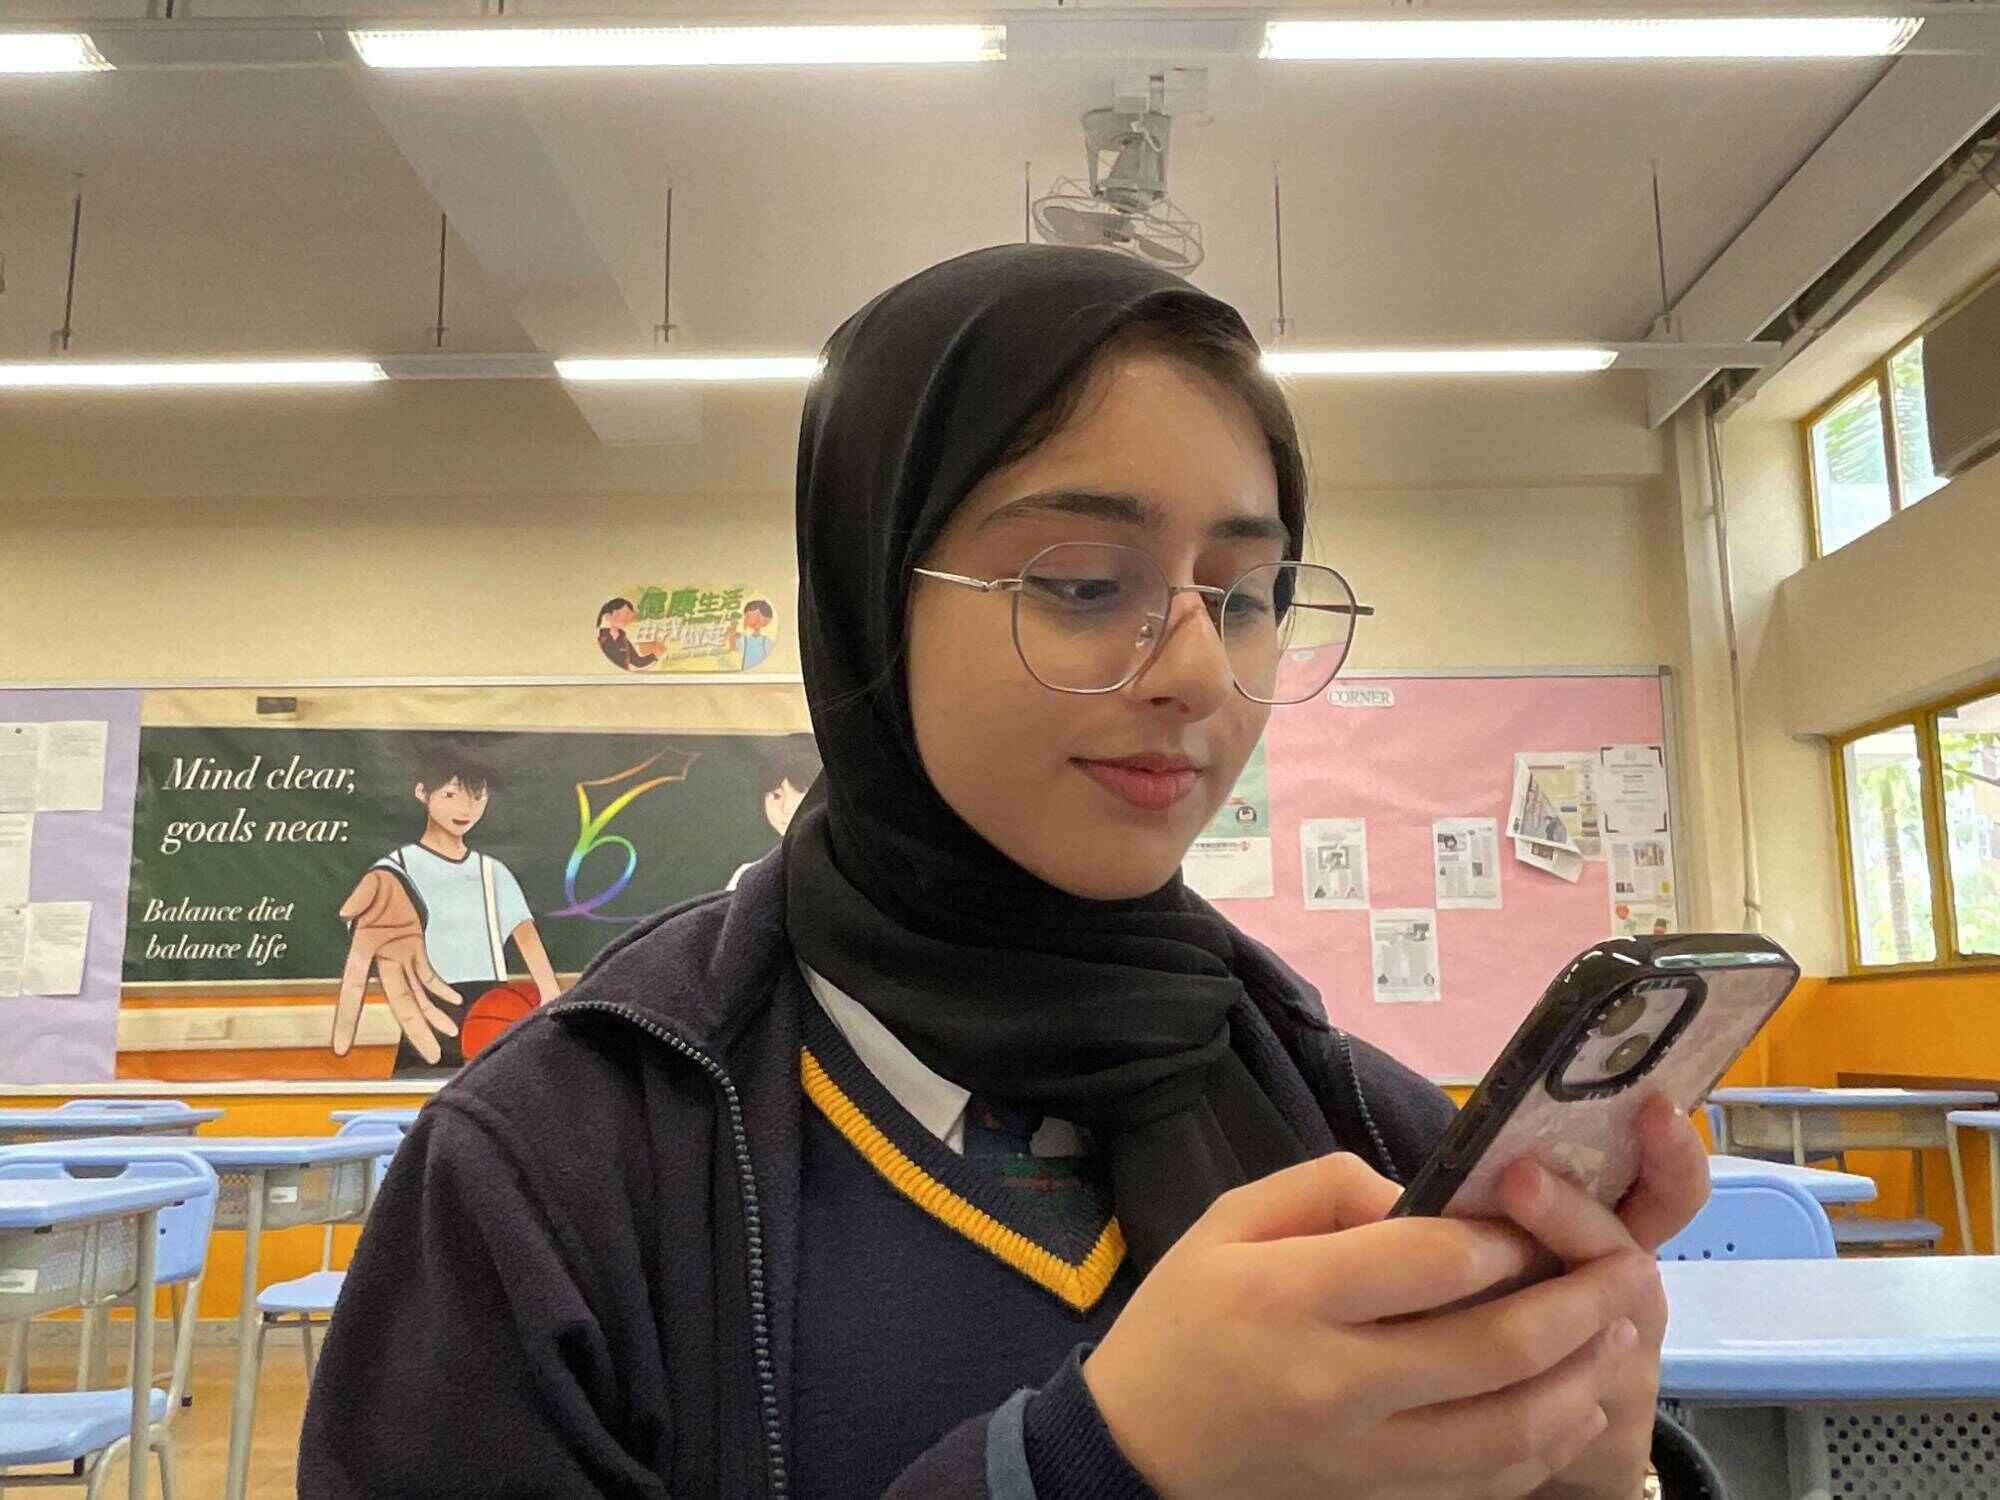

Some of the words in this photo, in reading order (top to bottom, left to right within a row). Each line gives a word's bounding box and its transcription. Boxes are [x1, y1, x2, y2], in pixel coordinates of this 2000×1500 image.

[1329, 690, 1391, 706] CORNER
[161, 755, 262, 790] Mind
[266, 755, 356, 794] clear,
[161, 808, 256, 855] goals
[265, 820, 349, 842] near.
[143, 897, 243, 922] Balance
[248, 897, 295, 922] diet
[145, 934, 242, 960] balance
[246, 934, 288, 966] life
